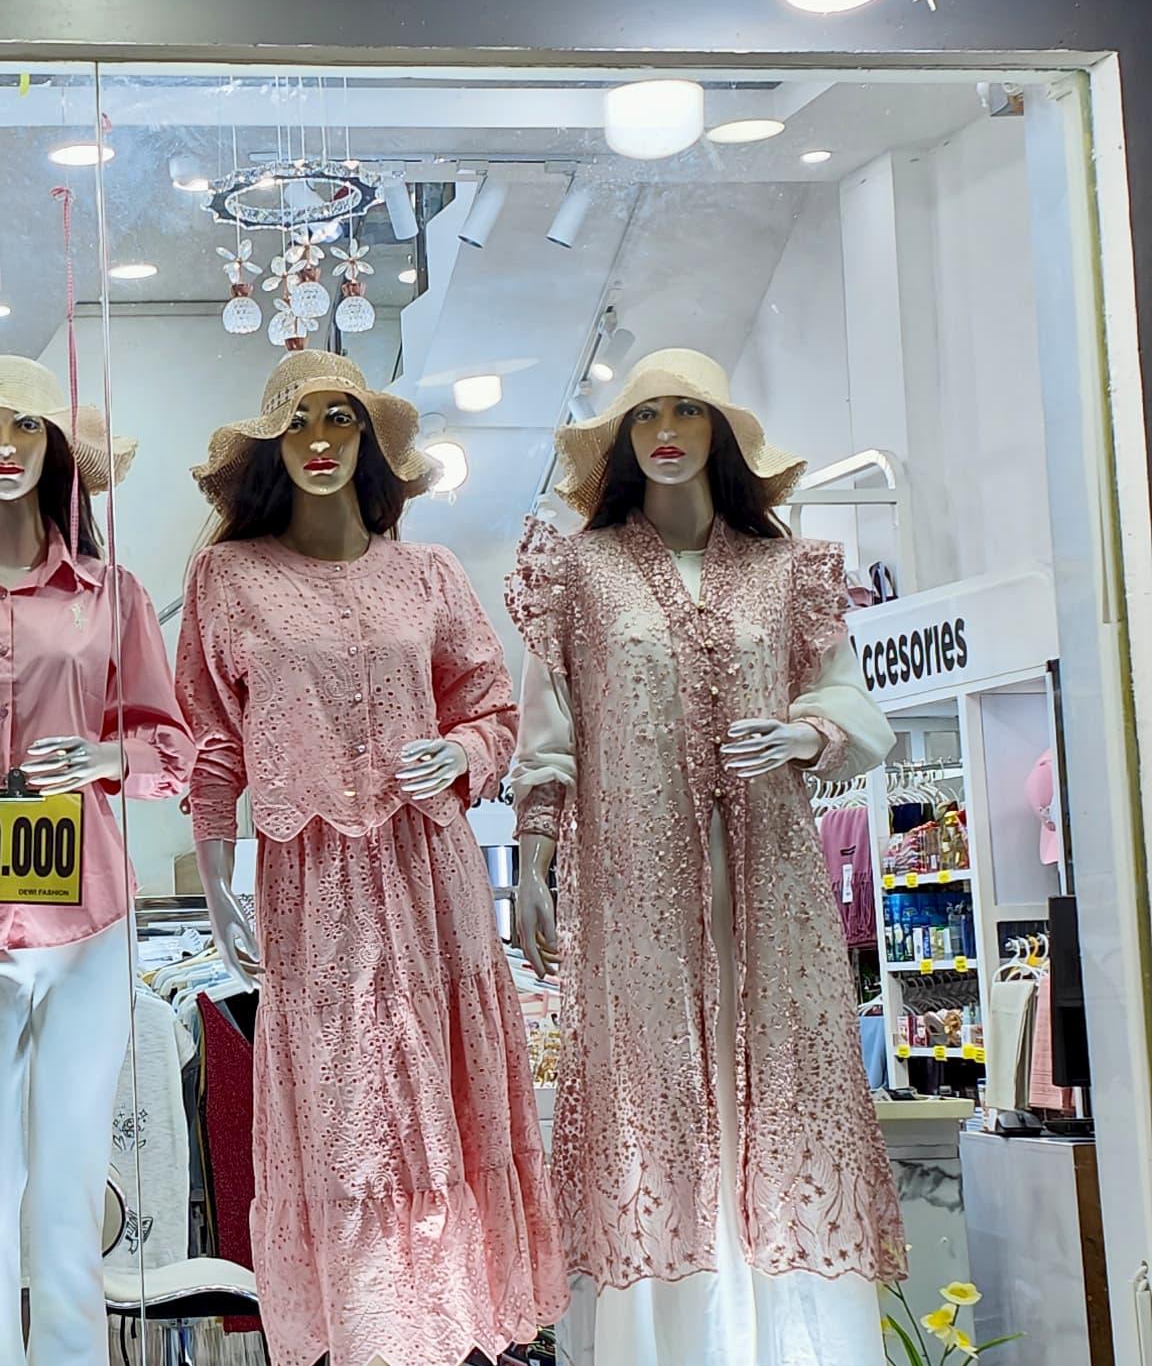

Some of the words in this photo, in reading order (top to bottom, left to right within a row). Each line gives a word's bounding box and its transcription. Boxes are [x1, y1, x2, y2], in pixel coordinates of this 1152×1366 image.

[850, 618, 968, 693] ccesories
[18, 888, 37, 896] DEWI
[38, 888, 70, 897] FASHION
